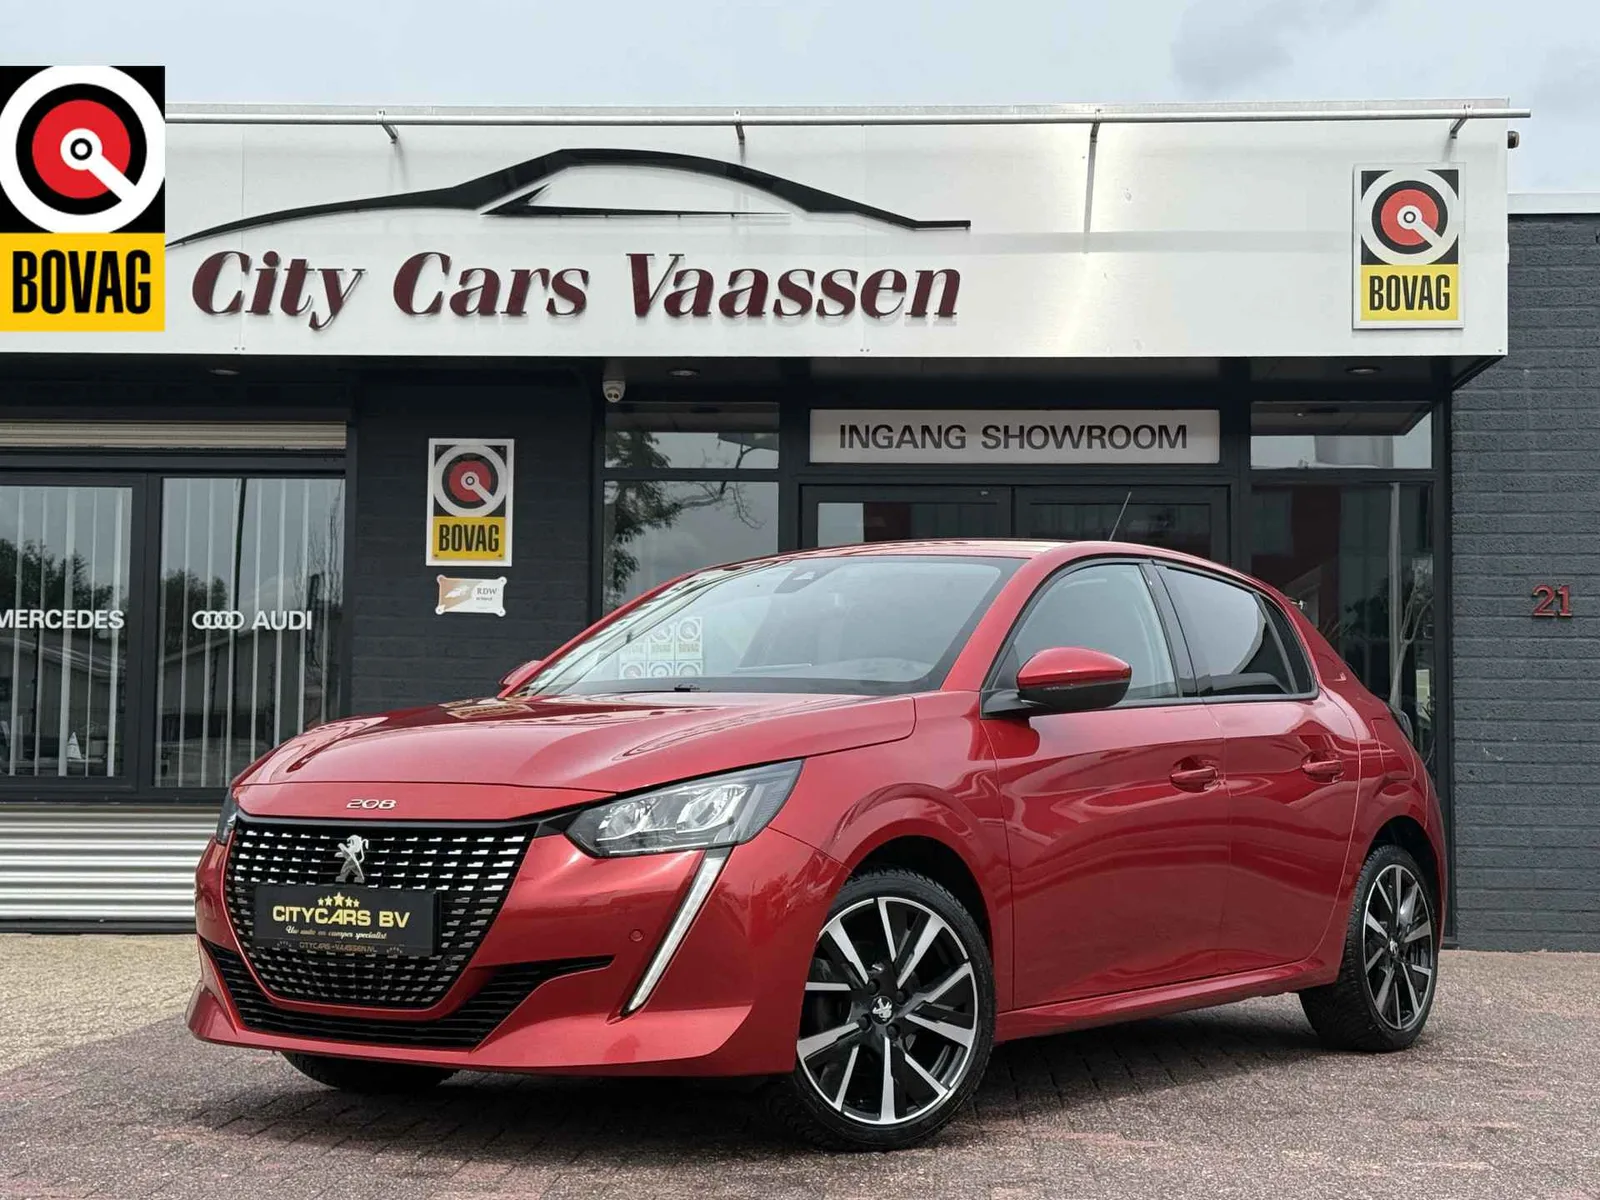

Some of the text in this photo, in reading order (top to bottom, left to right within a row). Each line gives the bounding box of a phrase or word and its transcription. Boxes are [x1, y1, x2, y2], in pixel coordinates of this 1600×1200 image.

[192, 250, 961, 331] City Cars Vaassen
[1369, 274, 1450, 311] BOVAG
[839, 423, 1188, 450] INGANG SHOWROOM
[438, 524, 500, 552] BOVAG
[476, 587, 498, 595] RDW
[1531, 583, 1573, 616] 21
[0, 608, 125, 630] MERCEDES
[251, 610, 313, 631] AUDI
[346, 798, 397, 810] 208
[272, 905, 410, 928] CITYCARS BV
